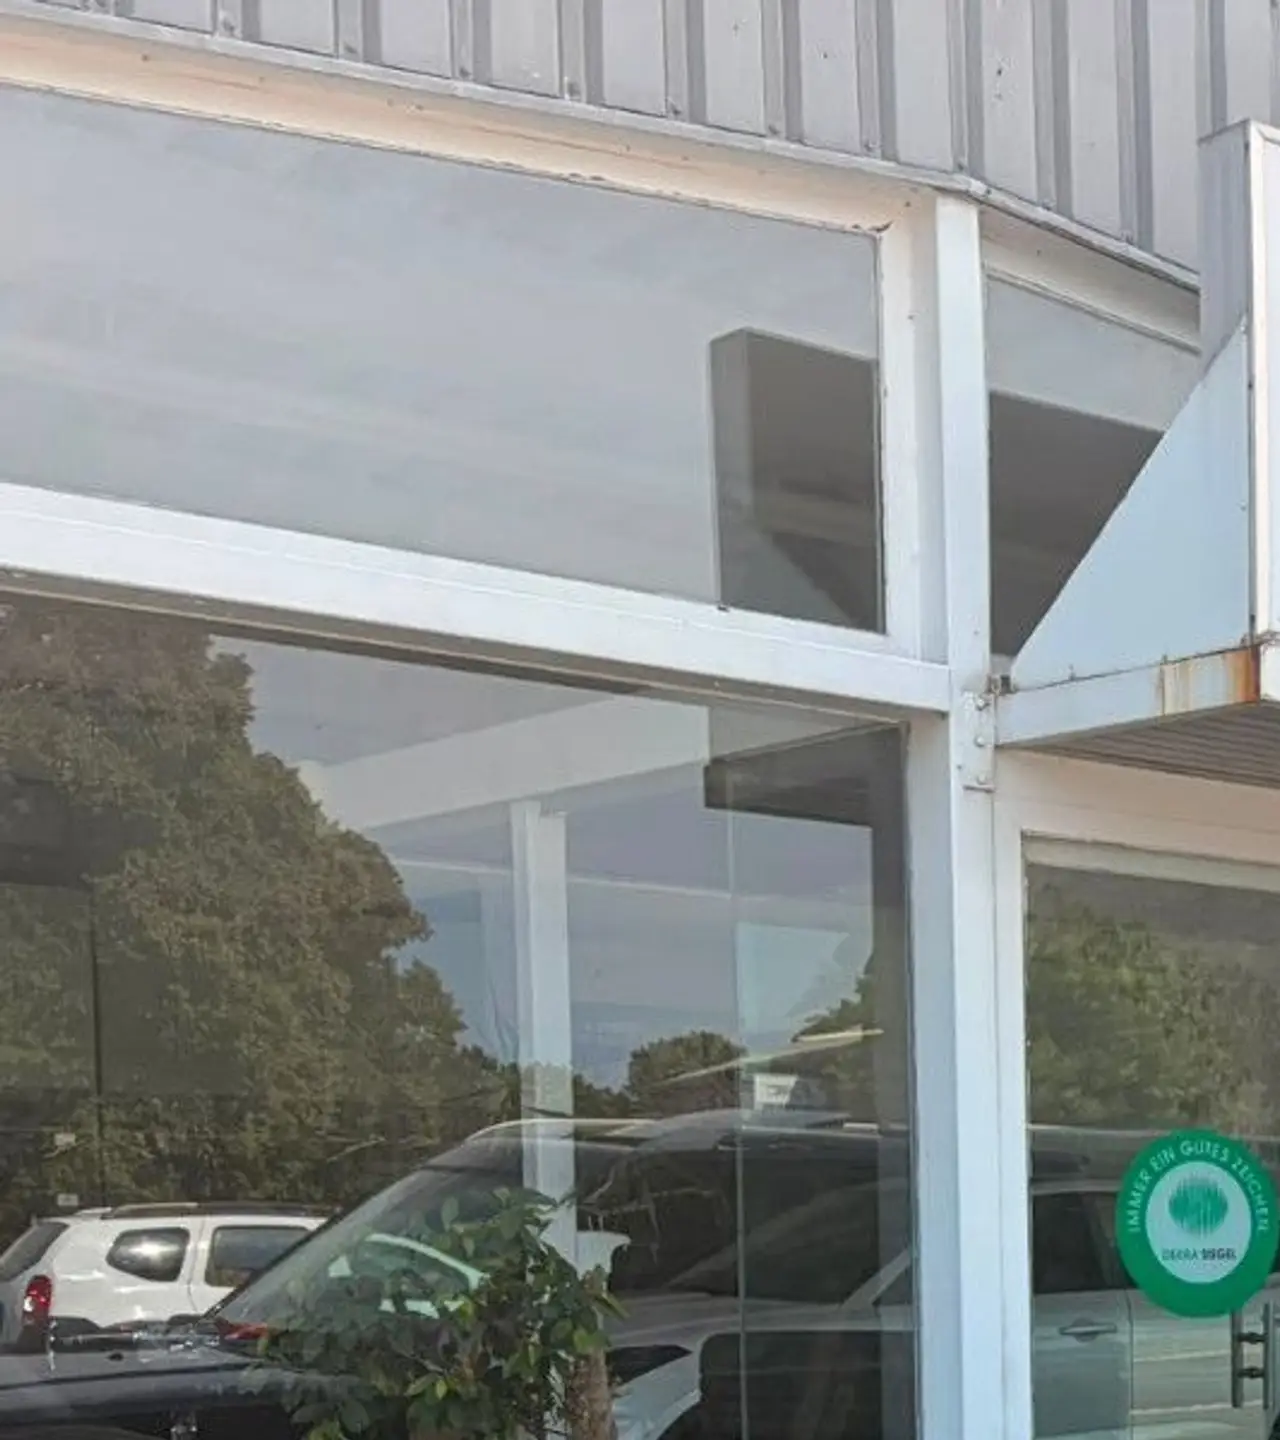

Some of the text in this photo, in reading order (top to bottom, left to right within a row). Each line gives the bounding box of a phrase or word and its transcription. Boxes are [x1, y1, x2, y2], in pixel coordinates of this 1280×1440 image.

[1126, 1139, 1270, 1233] IMMER EIN GUTES ZEICHEN
